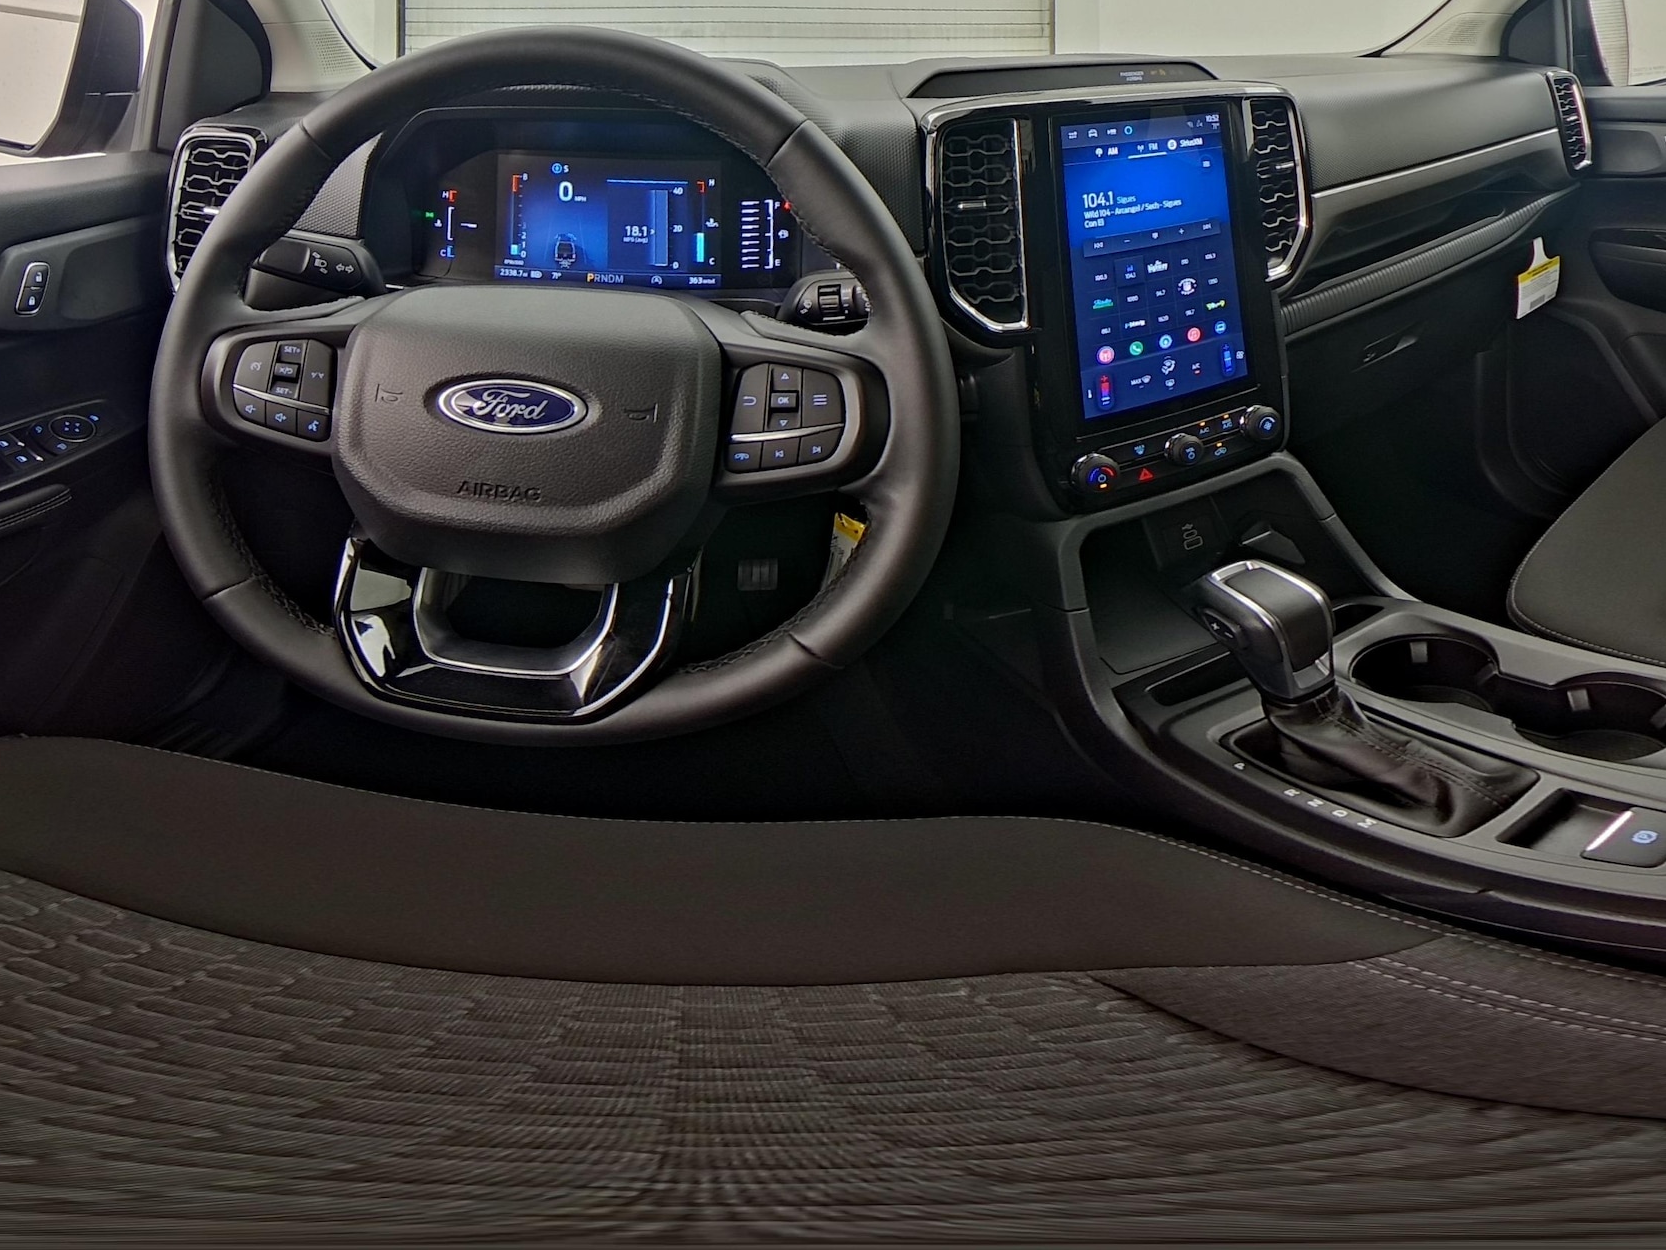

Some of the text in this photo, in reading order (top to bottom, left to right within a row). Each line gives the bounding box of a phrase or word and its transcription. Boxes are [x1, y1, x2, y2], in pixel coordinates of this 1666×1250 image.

[1107, 147, 1118, 155] AM
[559, 181, 573, 202] 0
[673, 187, 683, 195] 40
[1083, 191, 1113, 208] 104.1
[625, 226, 647, 236] 18.1
[285, 346, 301, 354] SET+
[473, 389, 549, 420] Ford
[777, 396, 789, 404] OK
[457, 480, 541, 503] AIRBAG
[1234, 762, 1245, 770] P
[1284, 788, 1300, 797] R
[1331, 809, 1349, 818] D
[1357, 818, 1377, 828] M
